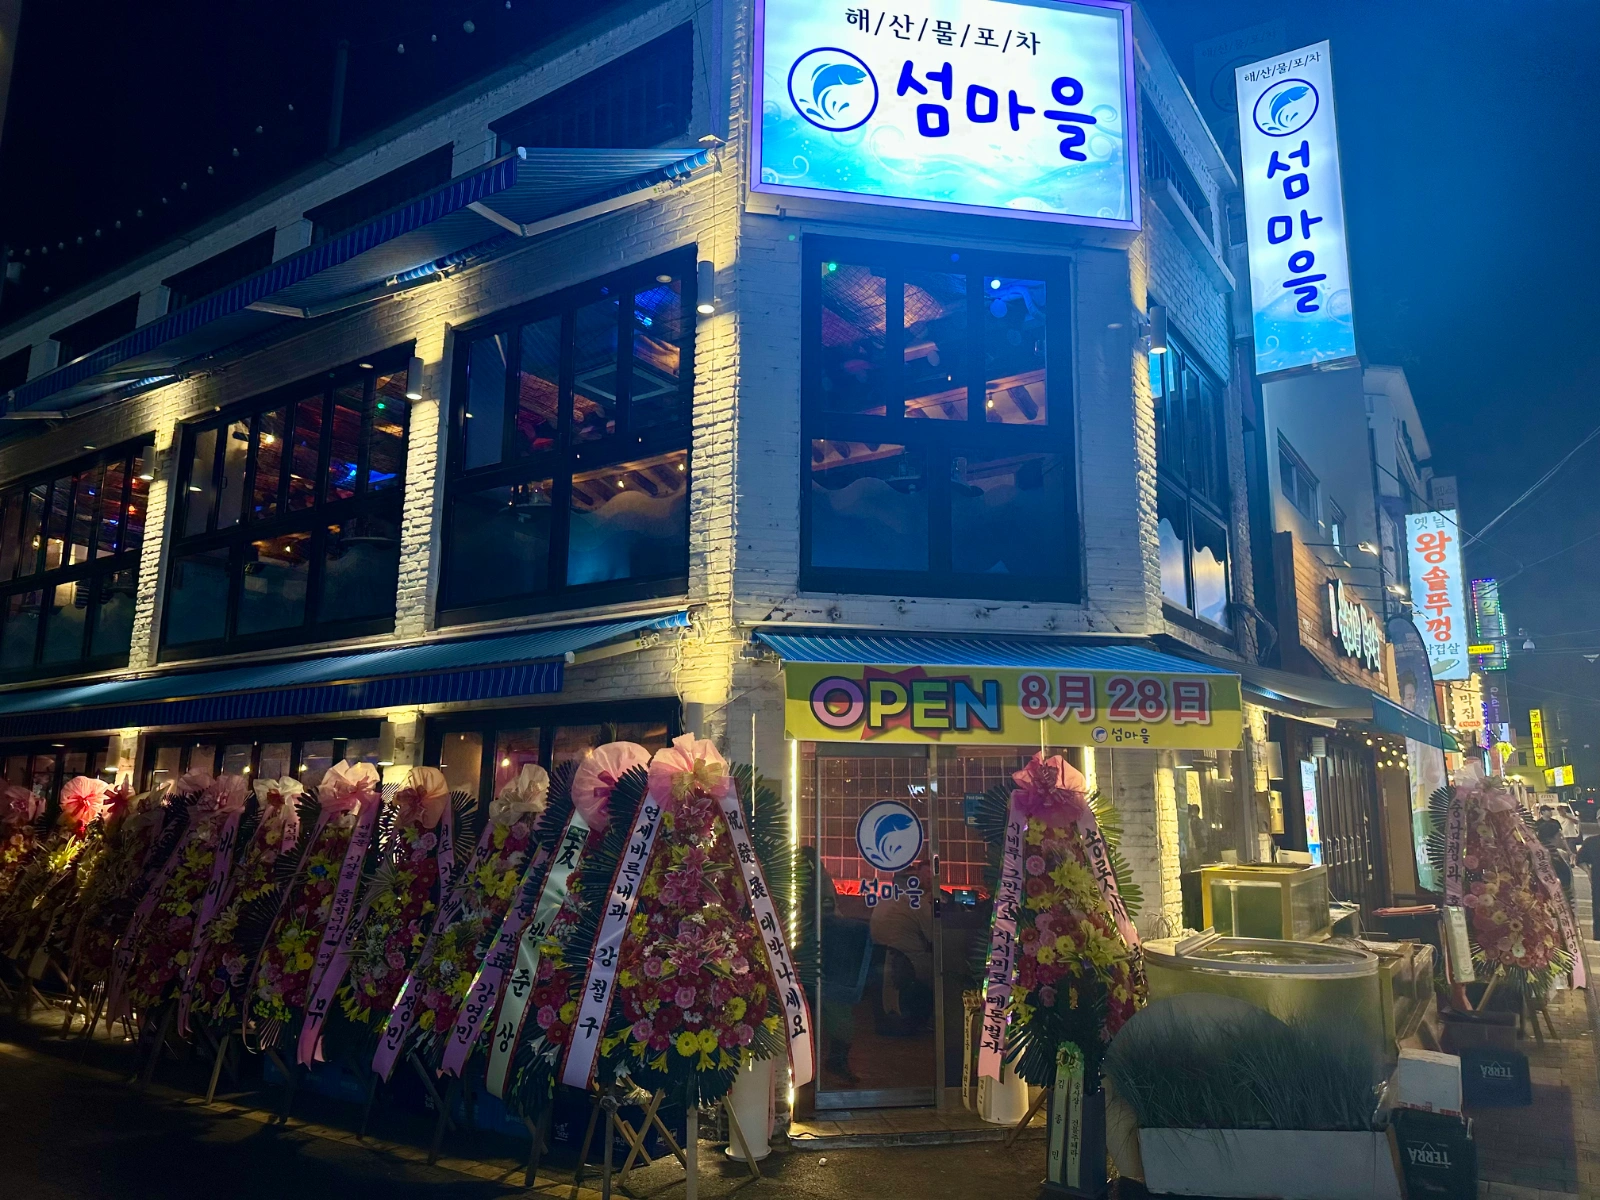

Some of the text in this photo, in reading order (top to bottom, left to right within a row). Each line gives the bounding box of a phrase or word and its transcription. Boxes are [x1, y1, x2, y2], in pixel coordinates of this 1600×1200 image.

[897, 60, 1097, 161] 섬마을
[1267, 140, 1327, 314] 섬마을
[809, 672, 1211, 731] OPEN 8月 28日
[1111, 727, 1151, 744] 섬마을
[556, 841, 579, 869] 友
[608, 805, 660, 921] 연세바른내과
[859, 876, 923, 909] 섬마을
[760, 912, 806, 1039] 대박나세요
[990, 931, 1014, 986] 사시미로
[1480, 1064, 1514, 1078] TERRA
[1407, 1147, 1452, 1168] TERRA
